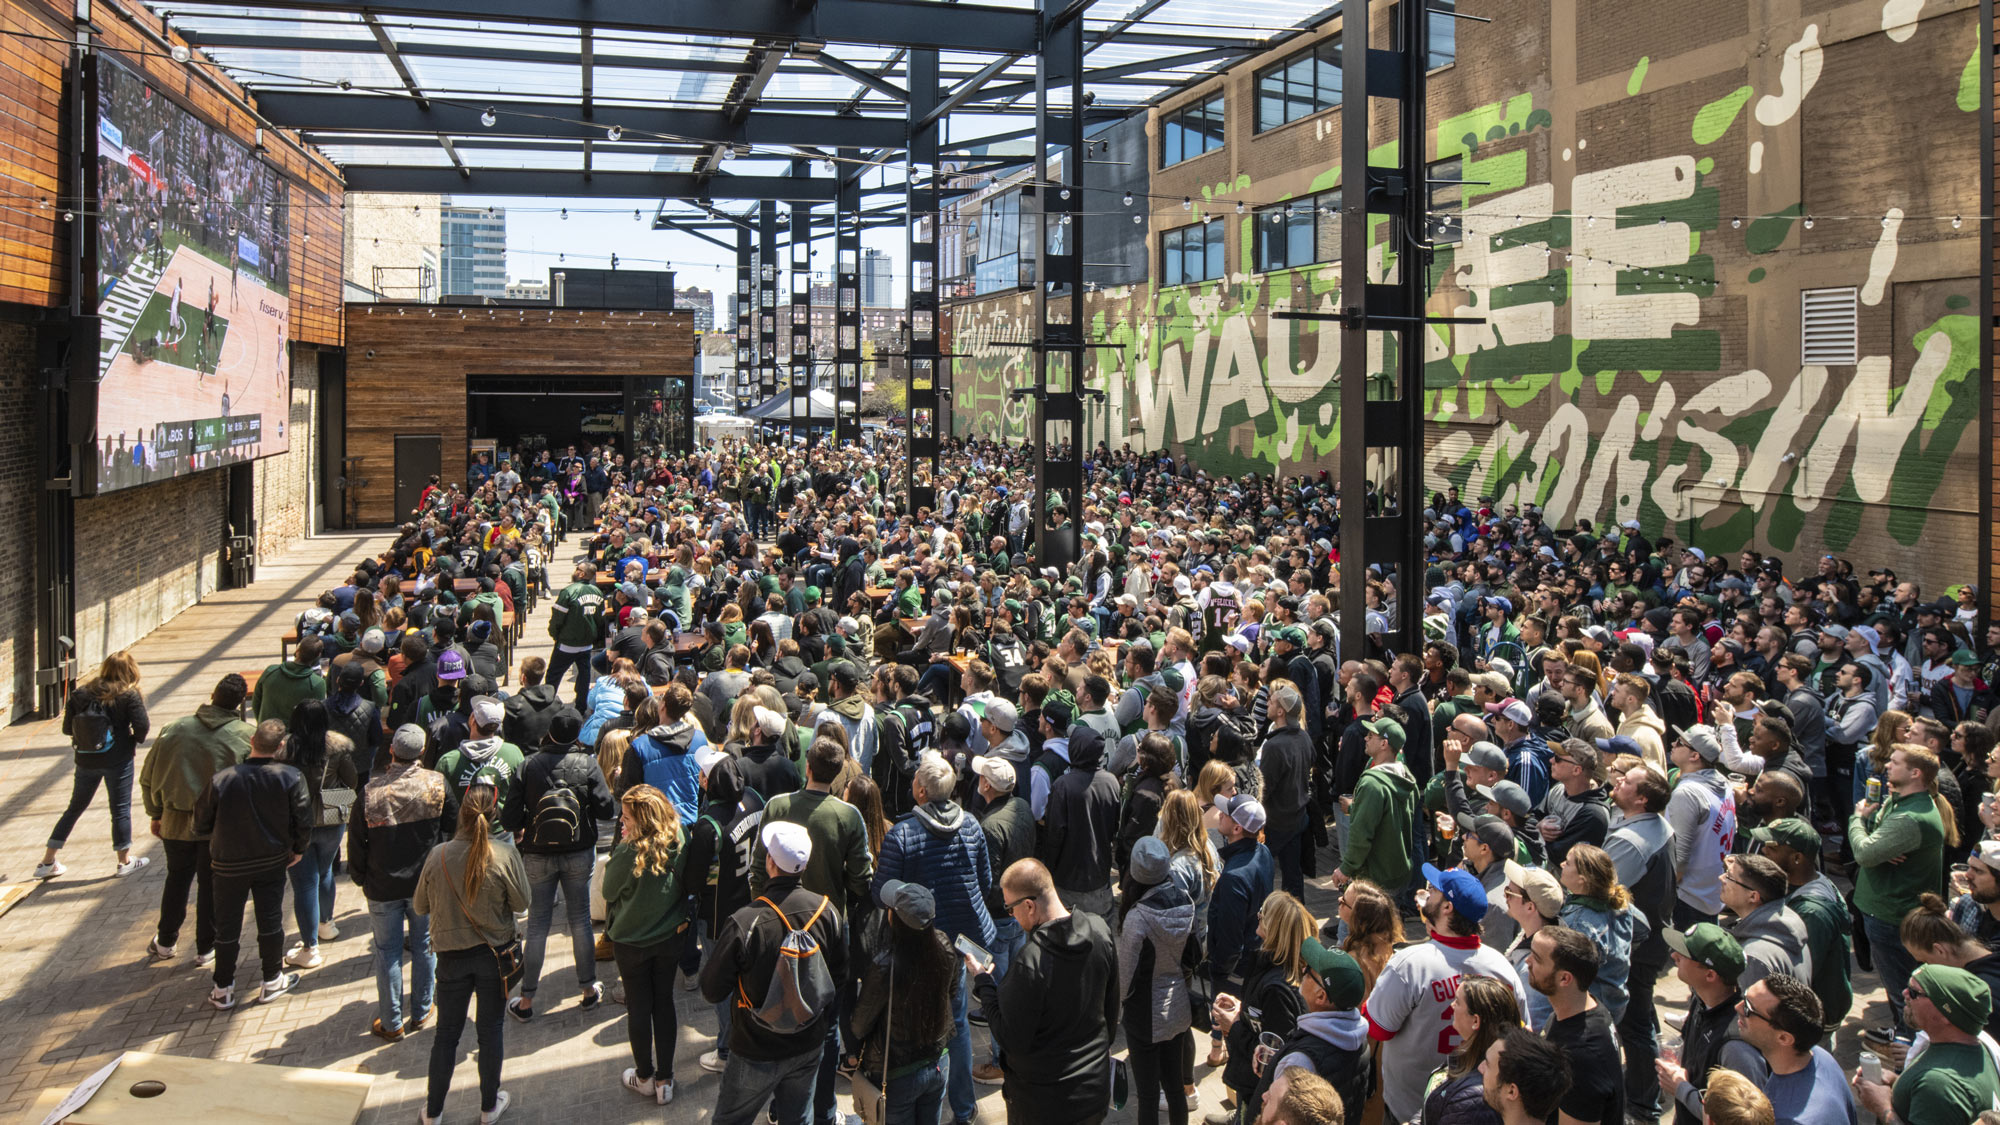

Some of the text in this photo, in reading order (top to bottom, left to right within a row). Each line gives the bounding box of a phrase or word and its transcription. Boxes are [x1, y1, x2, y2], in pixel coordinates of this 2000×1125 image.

[171, 429, 183, 442] BOS
[188, 427, 193, 440] 6
[205, 425, 215, 437] MIL
[1001, 648, 1024, 668] 34
